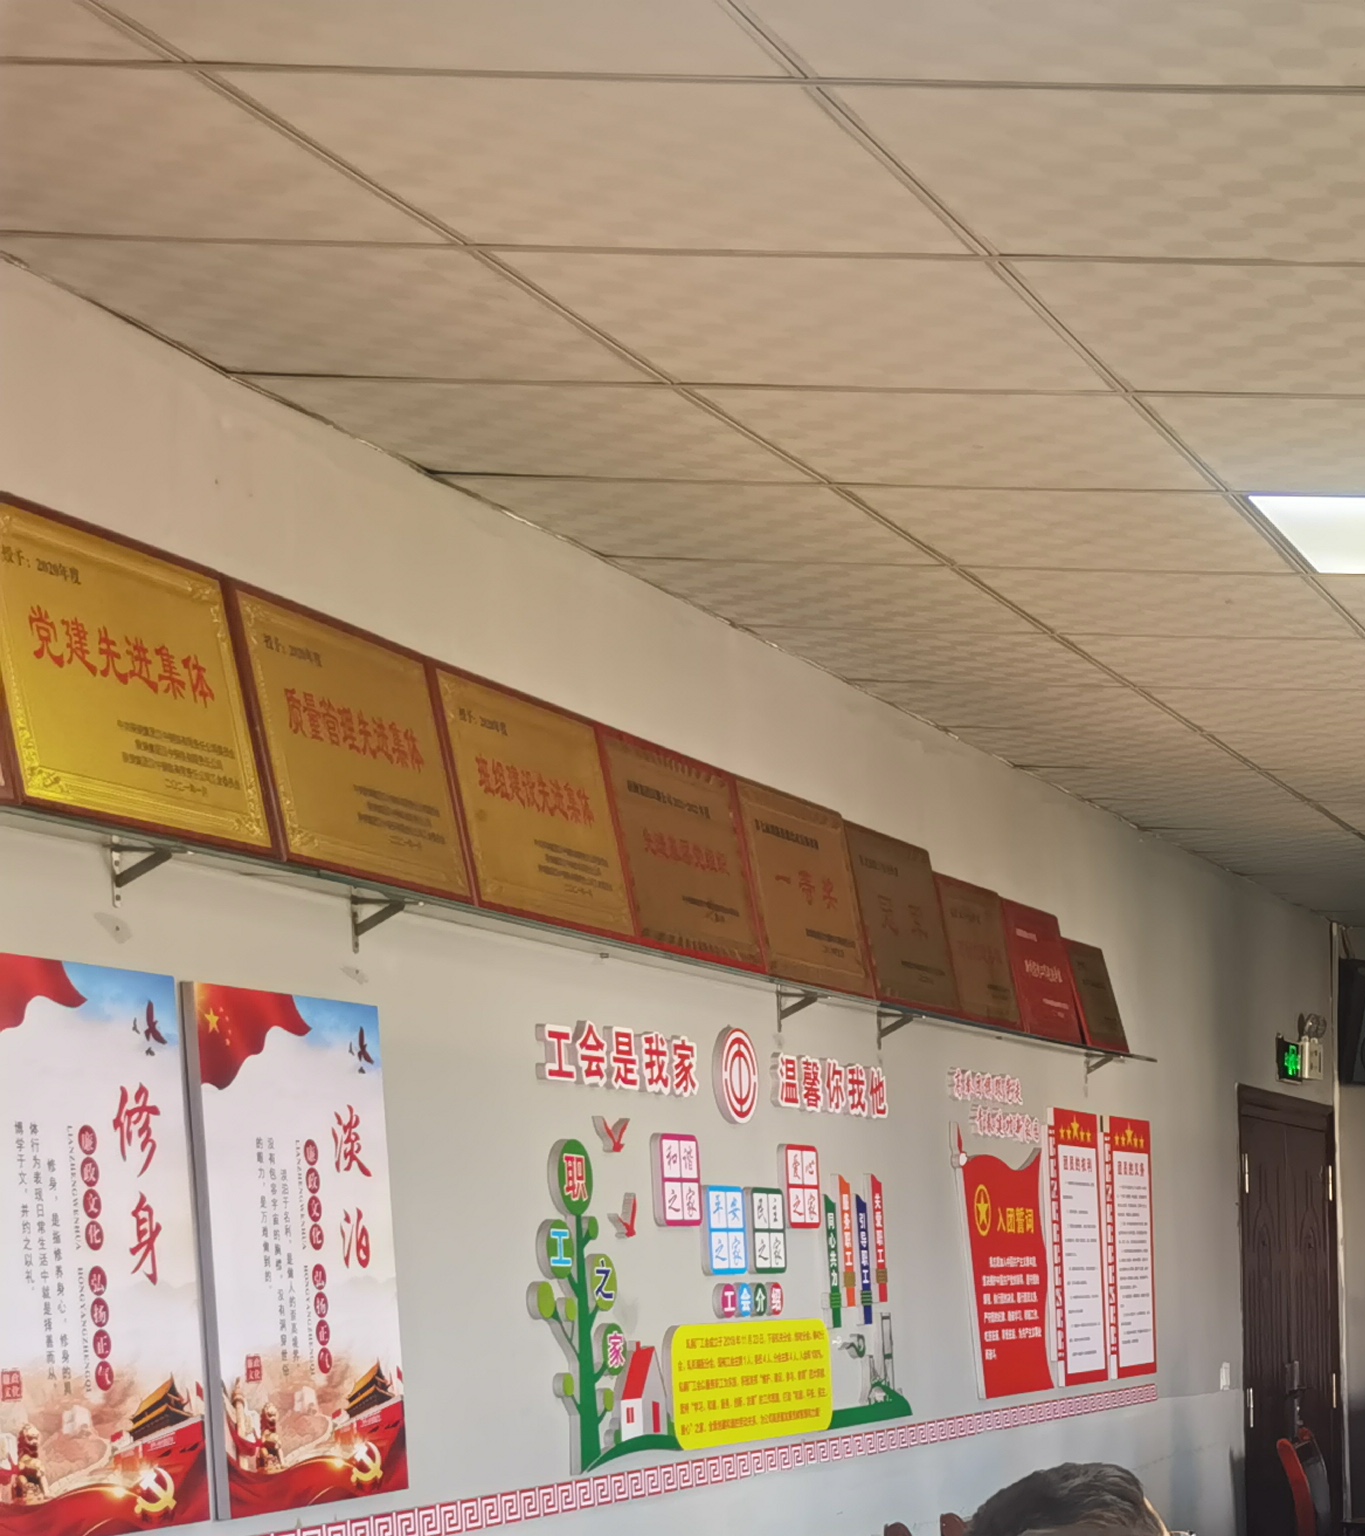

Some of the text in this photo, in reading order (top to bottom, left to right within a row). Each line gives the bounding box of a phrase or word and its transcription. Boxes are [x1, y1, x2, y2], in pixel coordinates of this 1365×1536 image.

[28, 604, 215, 708] 党建先进集体
[284, 688, 424, 773] 质量管理先进集体
[547, 1023, 698, 1096] 工会是我家
[780, 1054, 888, 1117] 温馨你我他
[112, 1081, 161, 1287] 修身
[304, 1141, 324, 1248] 廉政文化
[331, 1104, 372, 1269] 淡泊
[996, 1206, 1035, 1235] 入团誓词
[79, 1128, 112, 1388] 廉政文化 弘扬正气
[724, 1285, 783, 1313] 工会介绍
